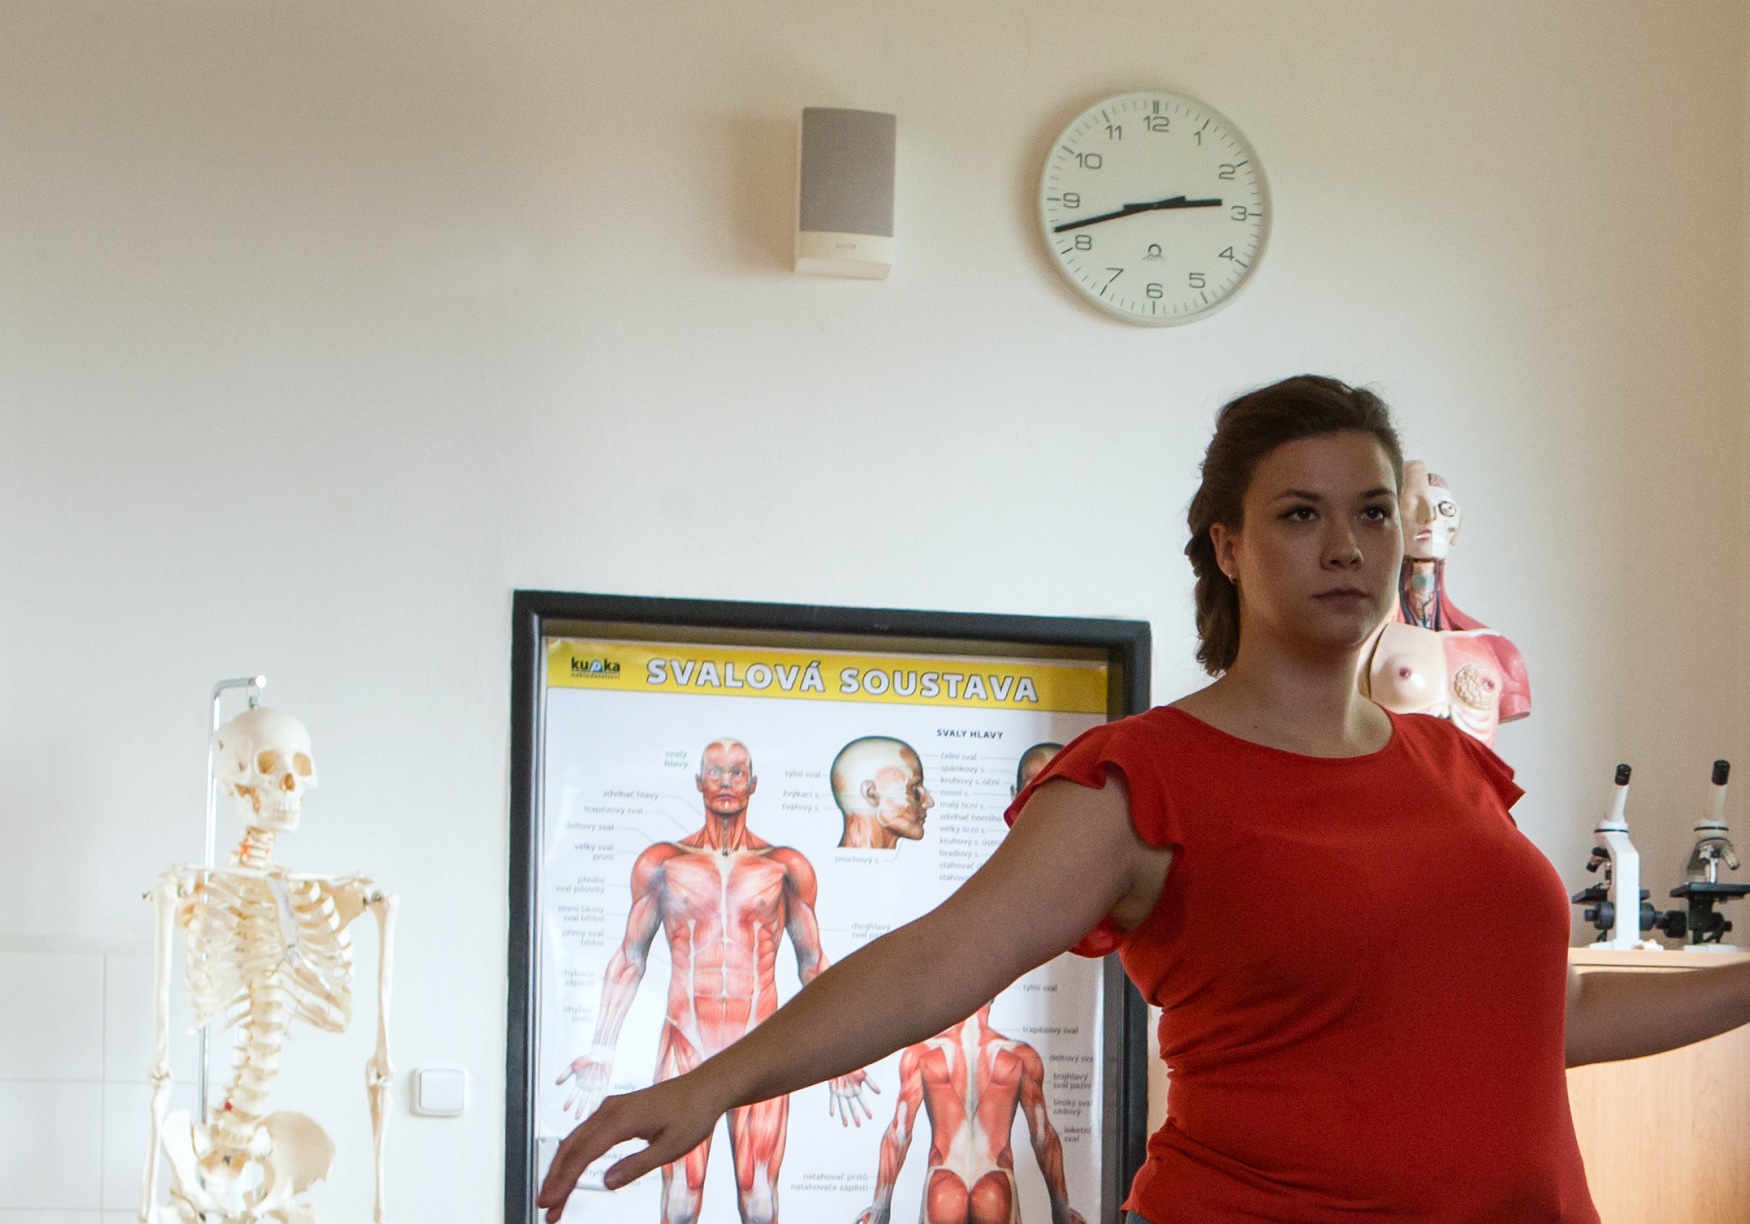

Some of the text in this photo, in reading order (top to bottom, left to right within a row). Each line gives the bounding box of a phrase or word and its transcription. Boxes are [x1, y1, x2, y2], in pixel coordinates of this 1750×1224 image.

[1143, 115, 1170, 132] 12
[1105, 125, 1122, 141] 11
[1194, 130, 1202, 146] 1
[1075, 152, 1102, 169] 10
[1218, 163, 1236, 180] 2
[1062, 192, 1081, 209] 9
[1230, 205, 1247, 221] 3
[1074, 234, 1092, 251] 8
[1218, 246, 1234, 261] 4
[1106, 267, 1124, 283] 7
[1189, 272, 1206, 289] 5
[1146, 283, 1163, 299] 6
[571, 656, 620, 672] kupka
[646, 658, 1039, 703] SVALOVÁ SOUSTAVA
[936, 729, 1003, 739] SVALY HLAVY
[665, 749, 688, 760] svaly
[664, 759, 689, 769] hlavy
[636, 791, 658, 800] hlavy
[556, 884, 572, 892] sval
[852, 931, 867, 939] sval
[1042, 984, 1058, 992] sval
